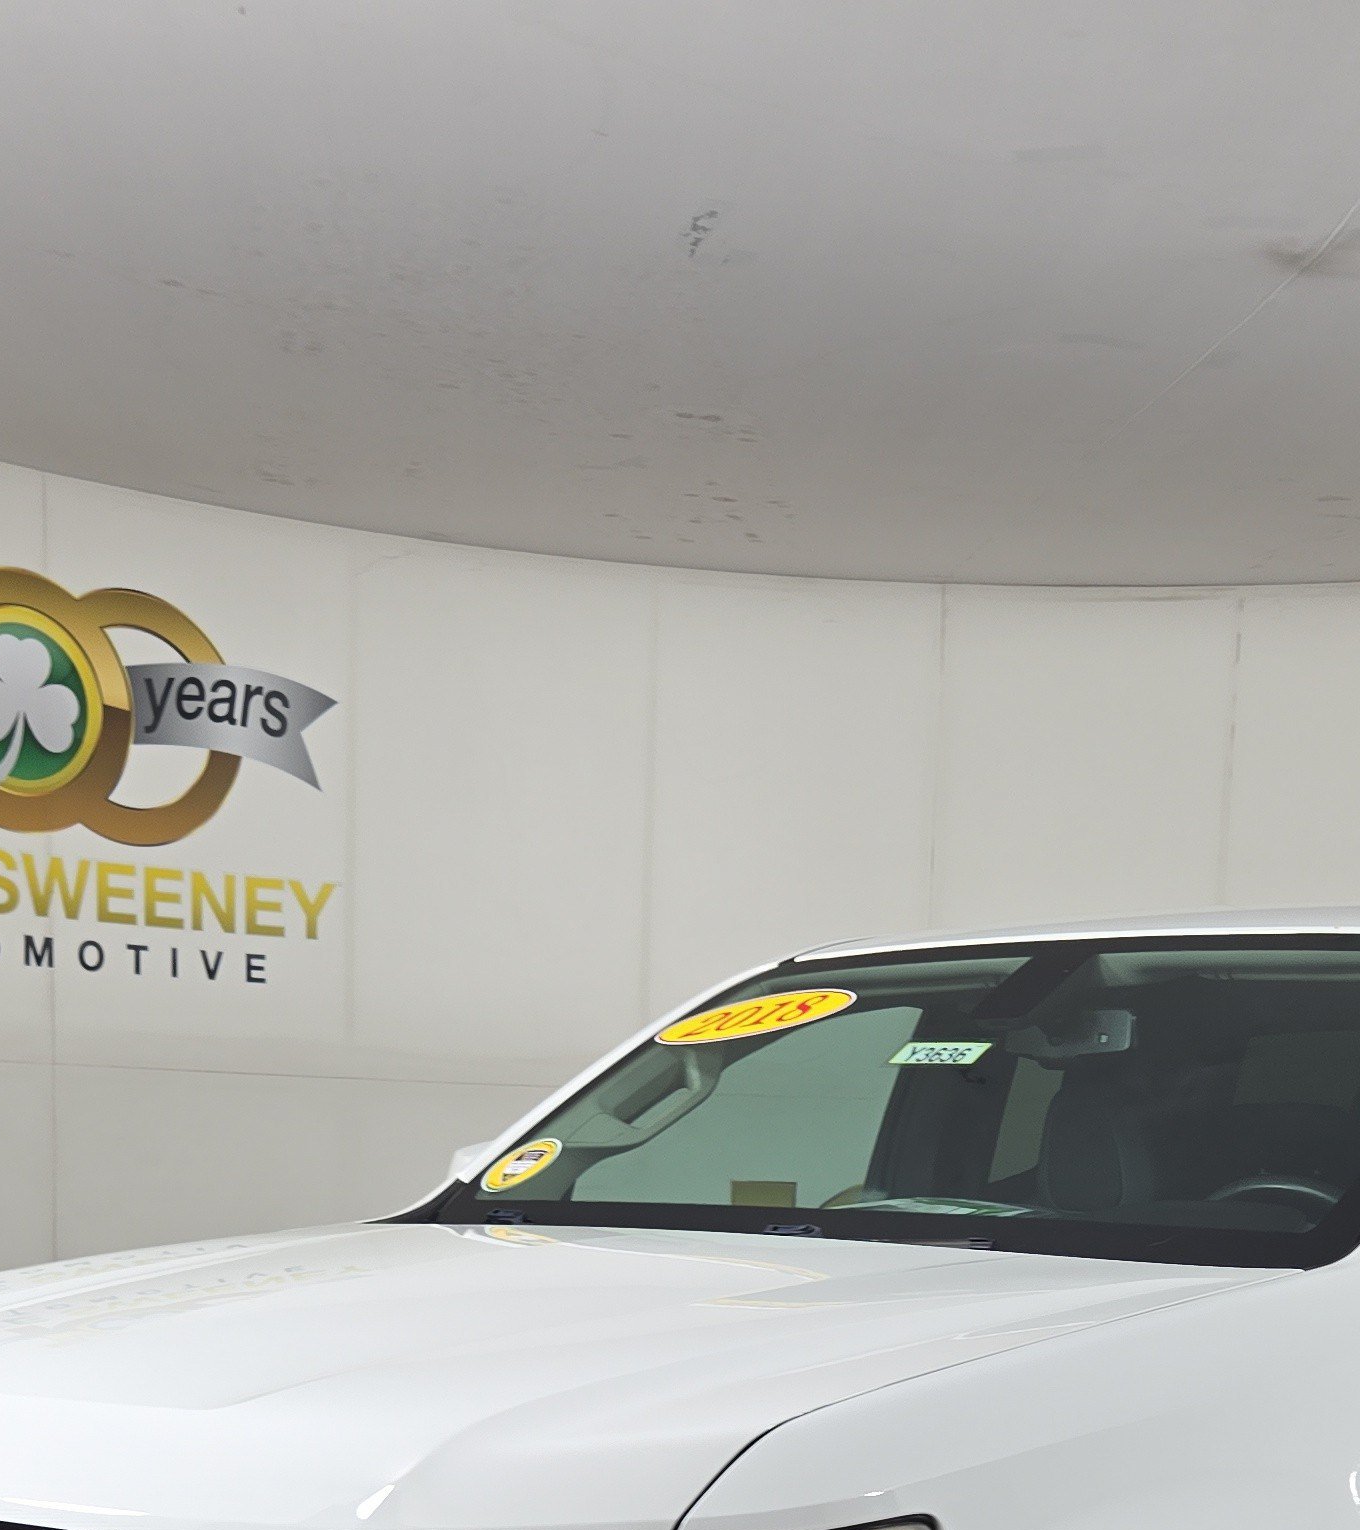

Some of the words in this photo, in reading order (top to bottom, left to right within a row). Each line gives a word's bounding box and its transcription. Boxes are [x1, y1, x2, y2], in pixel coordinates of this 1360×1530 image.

[142, 673, 291, 738] years
[676, 994, 830, 1040] 2018
[904, 1046, 973, 1063] Y3636
